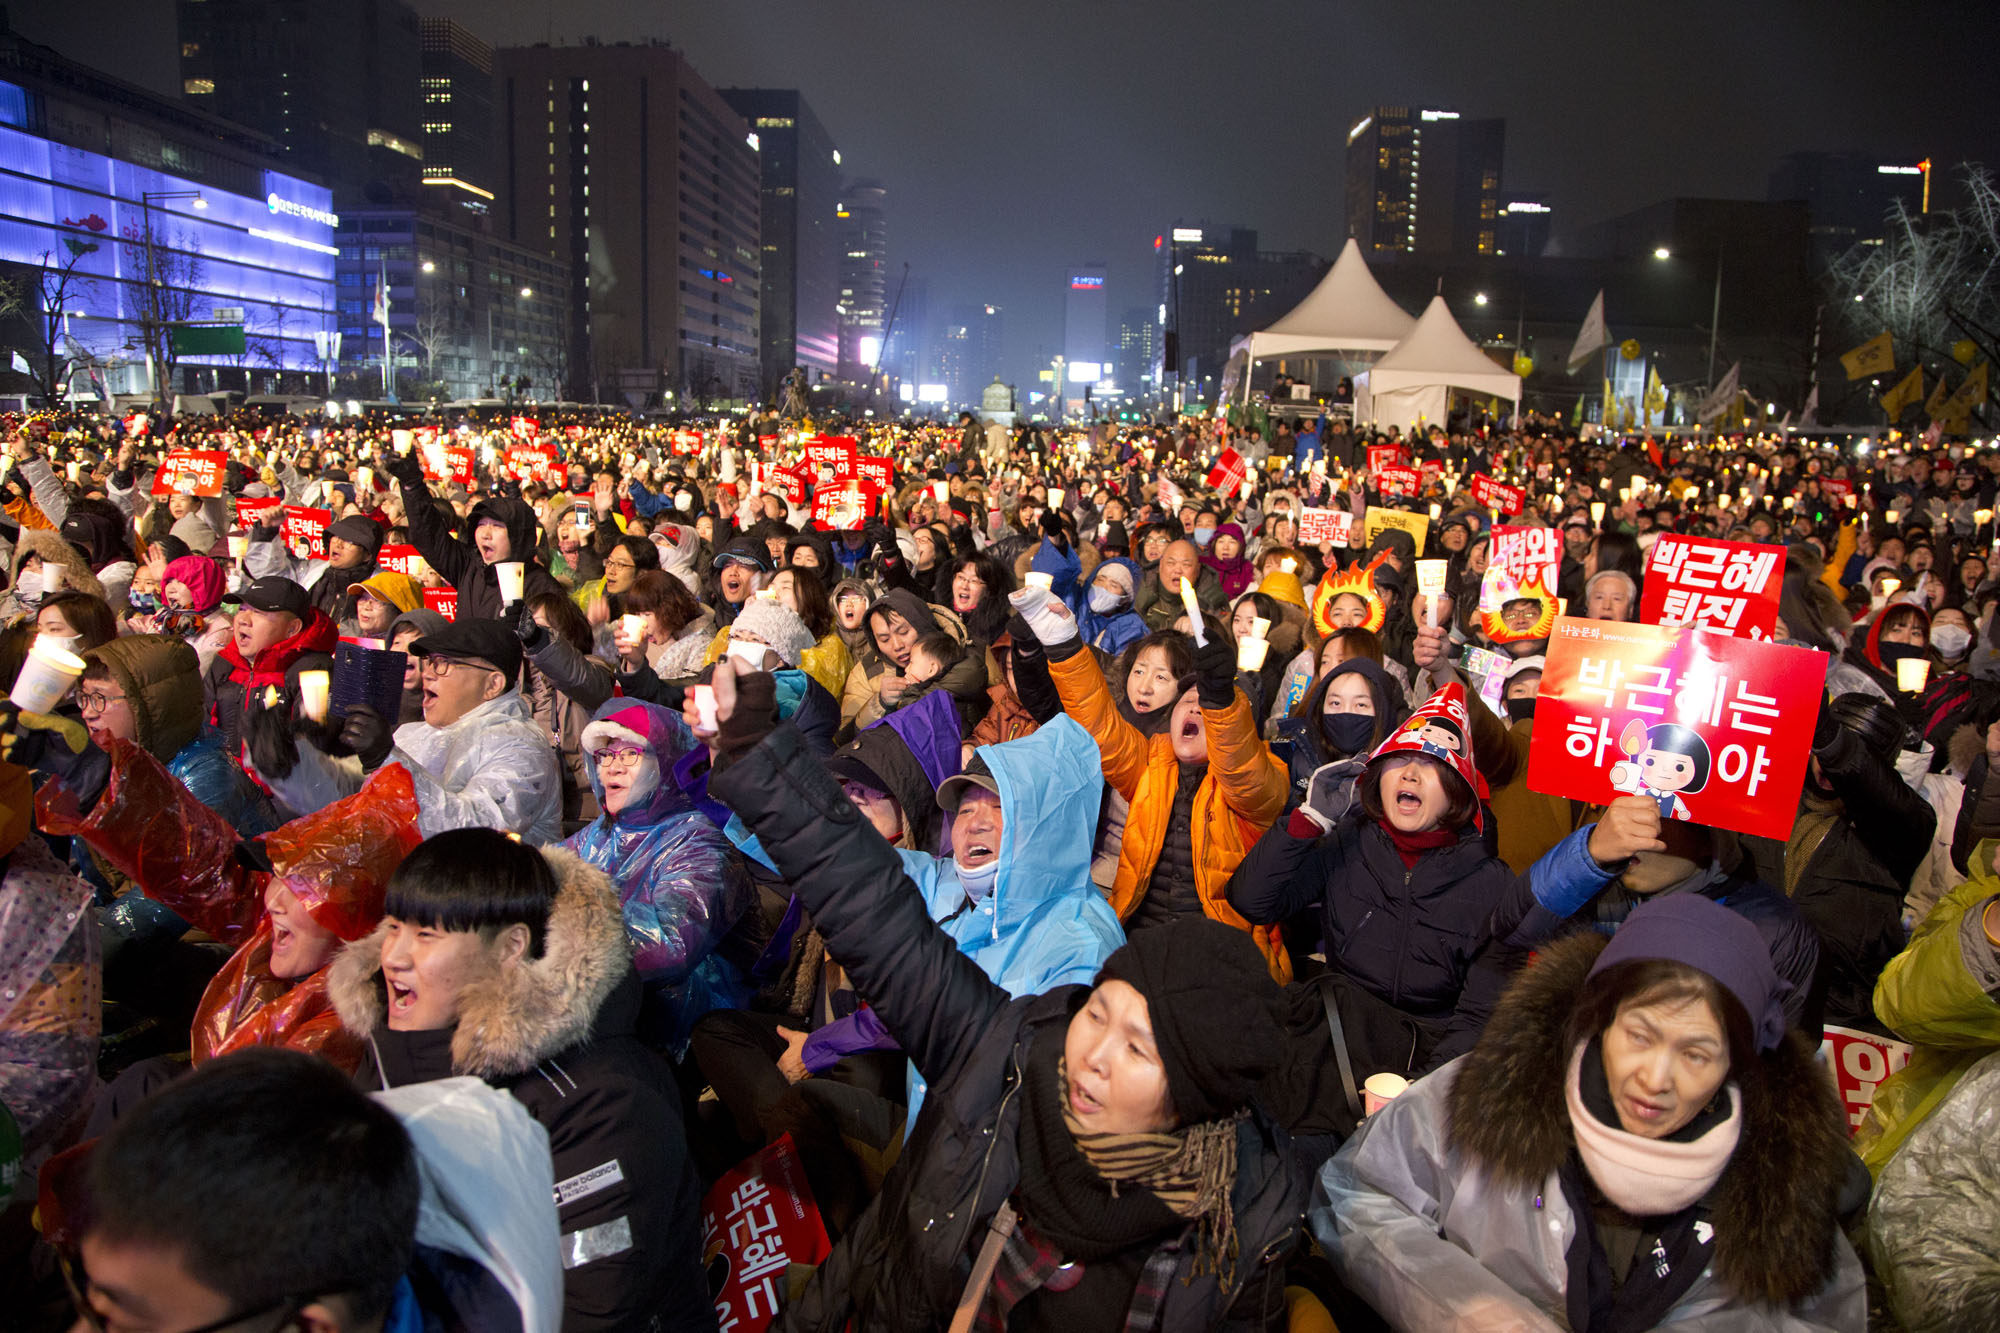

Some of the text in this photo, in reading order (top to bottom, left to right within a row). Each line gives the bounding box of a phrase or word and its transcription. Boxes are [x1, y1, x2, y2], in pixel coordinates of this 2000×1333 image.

[808, 447, 849, 461] 박근혜는
[166, 458, 217, 473] 박근혜는
[200, 474, 215, 488] 야
[819, 490, 867, 505] 박근혜는
[288, 517, 324, 537] 박근혜는
[1302, 513, 1341, 528] 박근혜
[1651, 540, 1778, 594] 박근혜
[1658, 588, 1748, 636] 퇴진
[1578, 657, 1780, 735] 박근혜는
[1565, 715, 1771, 796] 하 야
[560, 1163, 618, 1192] new balance
[563, 1184, 590, 1199] PATROL
